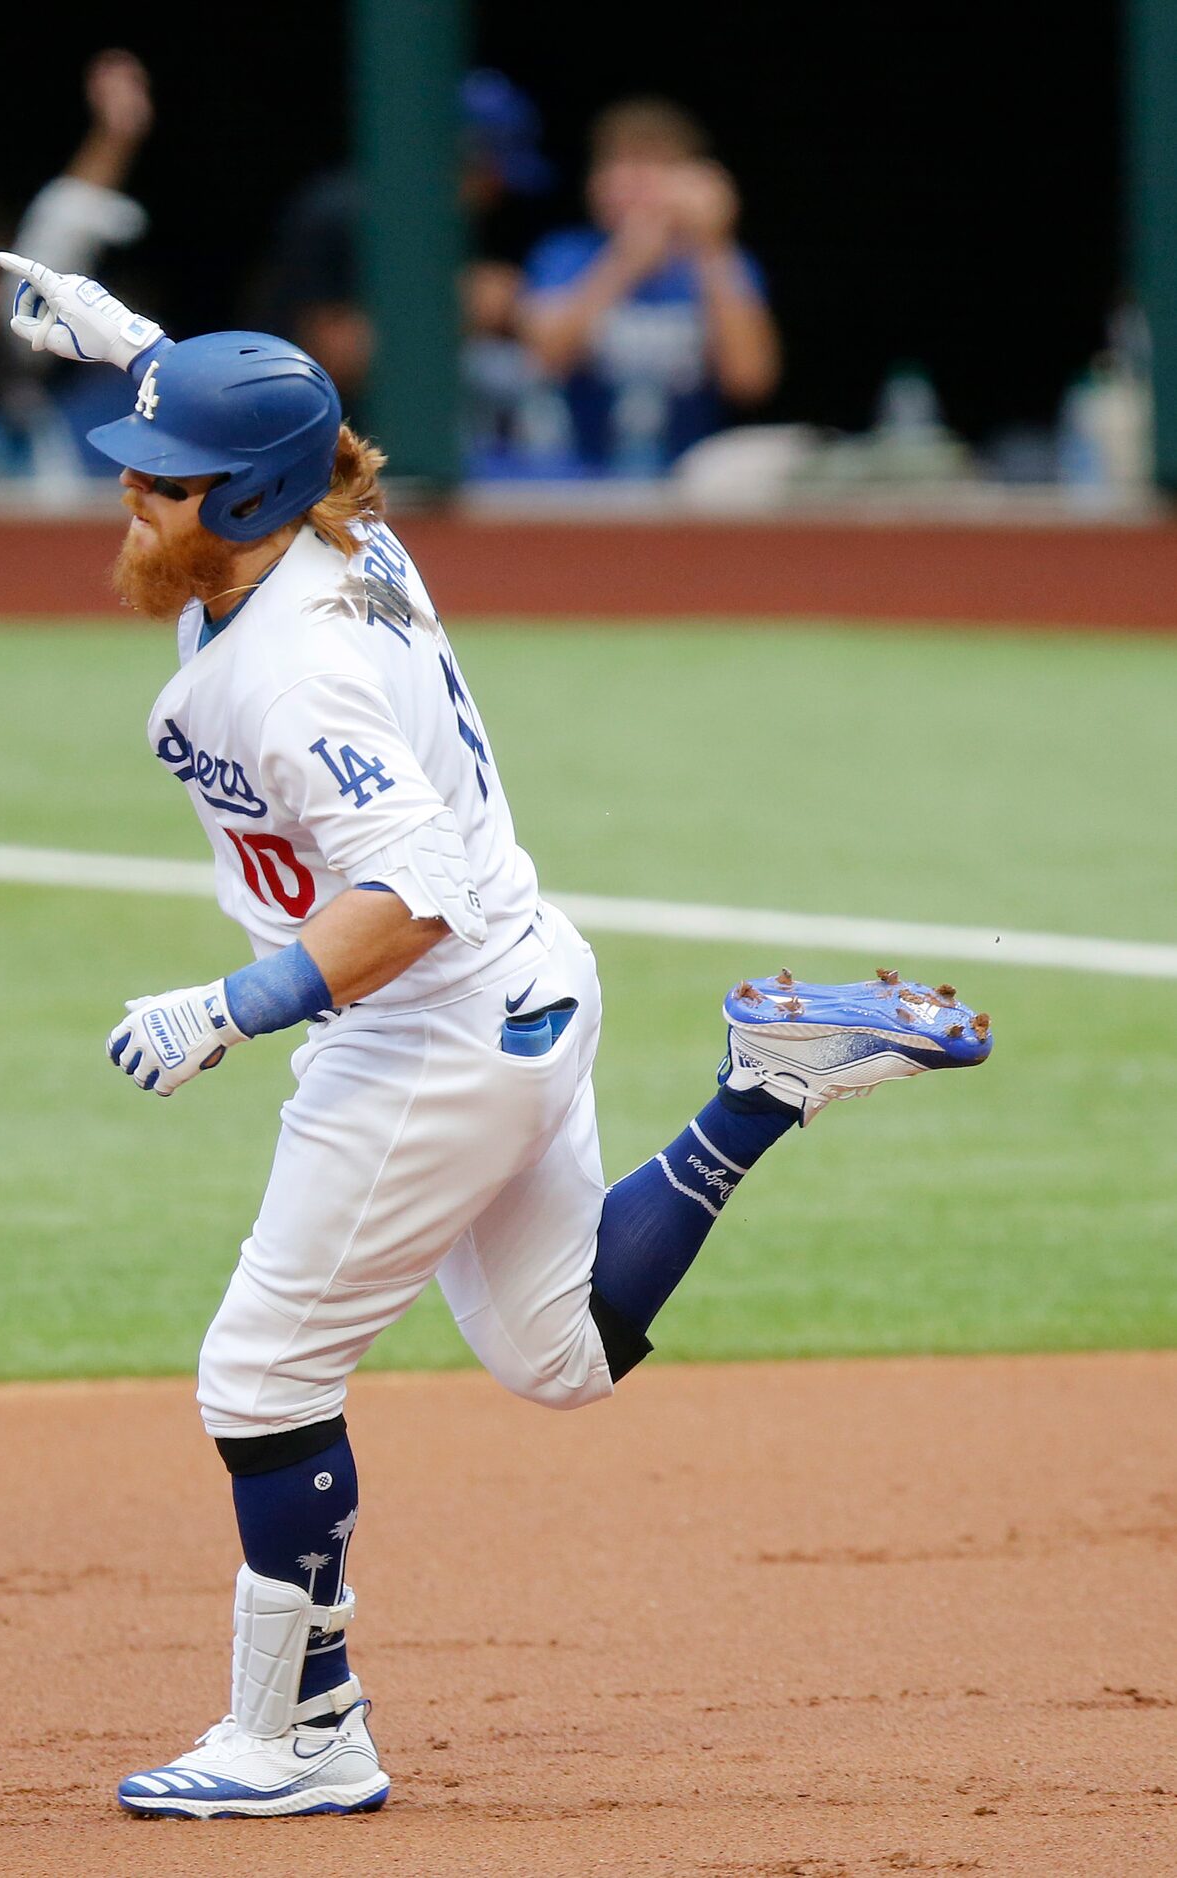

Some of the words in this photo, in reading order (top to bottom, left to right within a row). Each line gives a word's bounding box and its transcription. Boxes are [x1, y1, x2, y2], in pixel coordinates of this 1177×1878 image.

[309, 737, 396, 809] LA
[222, 827, 316, 919] 10
[149, 1013, 182, 1061] Franklin
